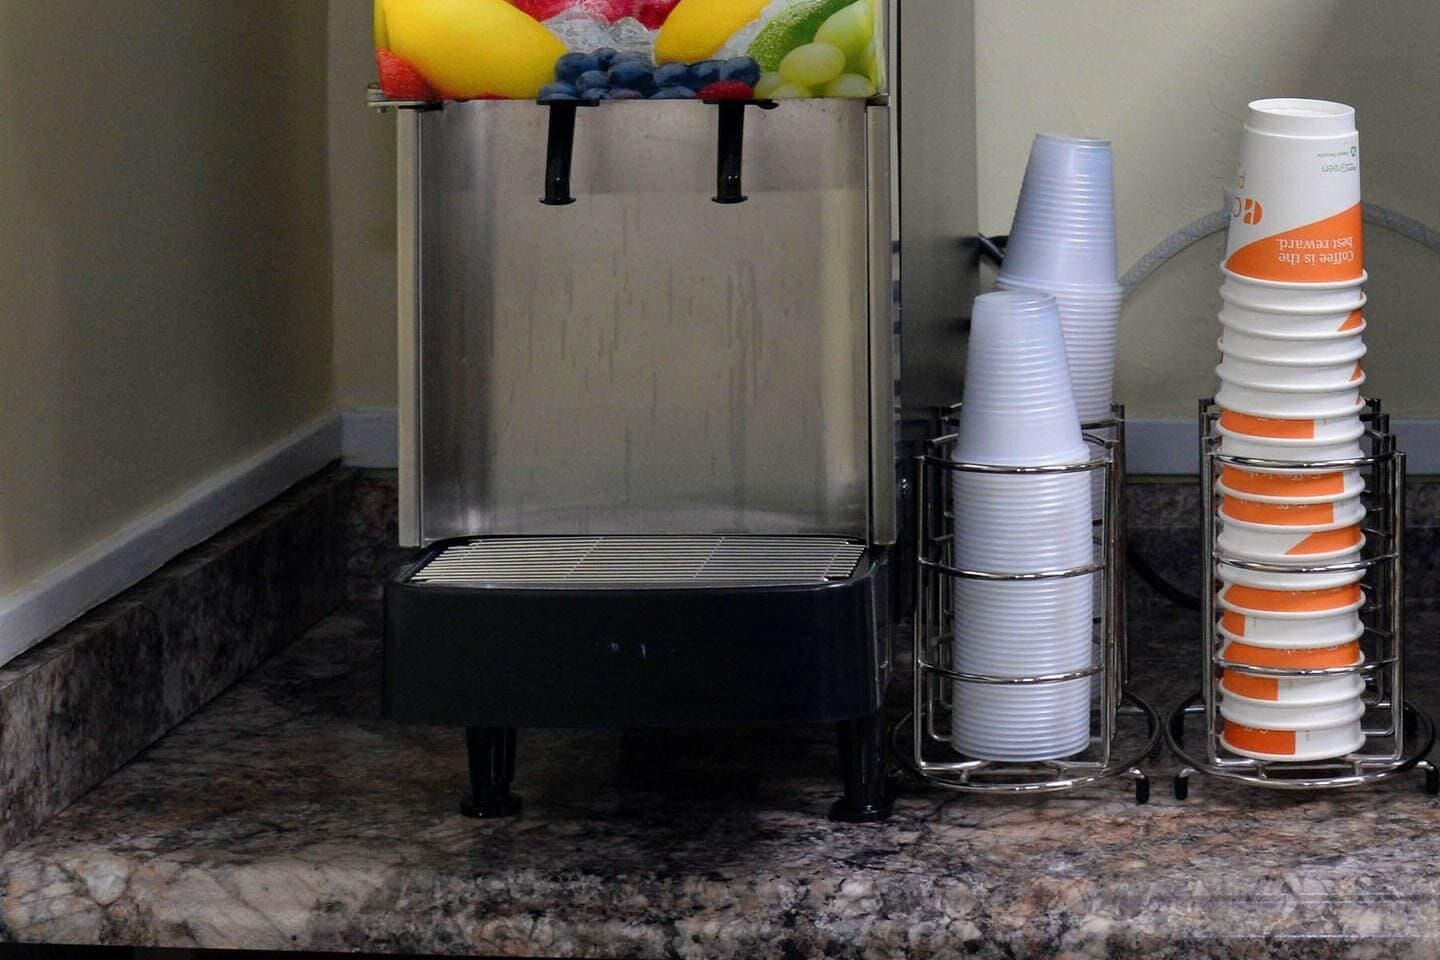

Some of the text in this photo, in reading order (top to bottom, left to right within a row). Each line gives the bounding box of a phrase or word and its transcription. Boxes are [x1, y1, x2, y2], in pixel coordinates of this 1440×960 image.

[1332, 236, 1353, 249] best
[1278, 251, 1354, 265] Coffee is the
